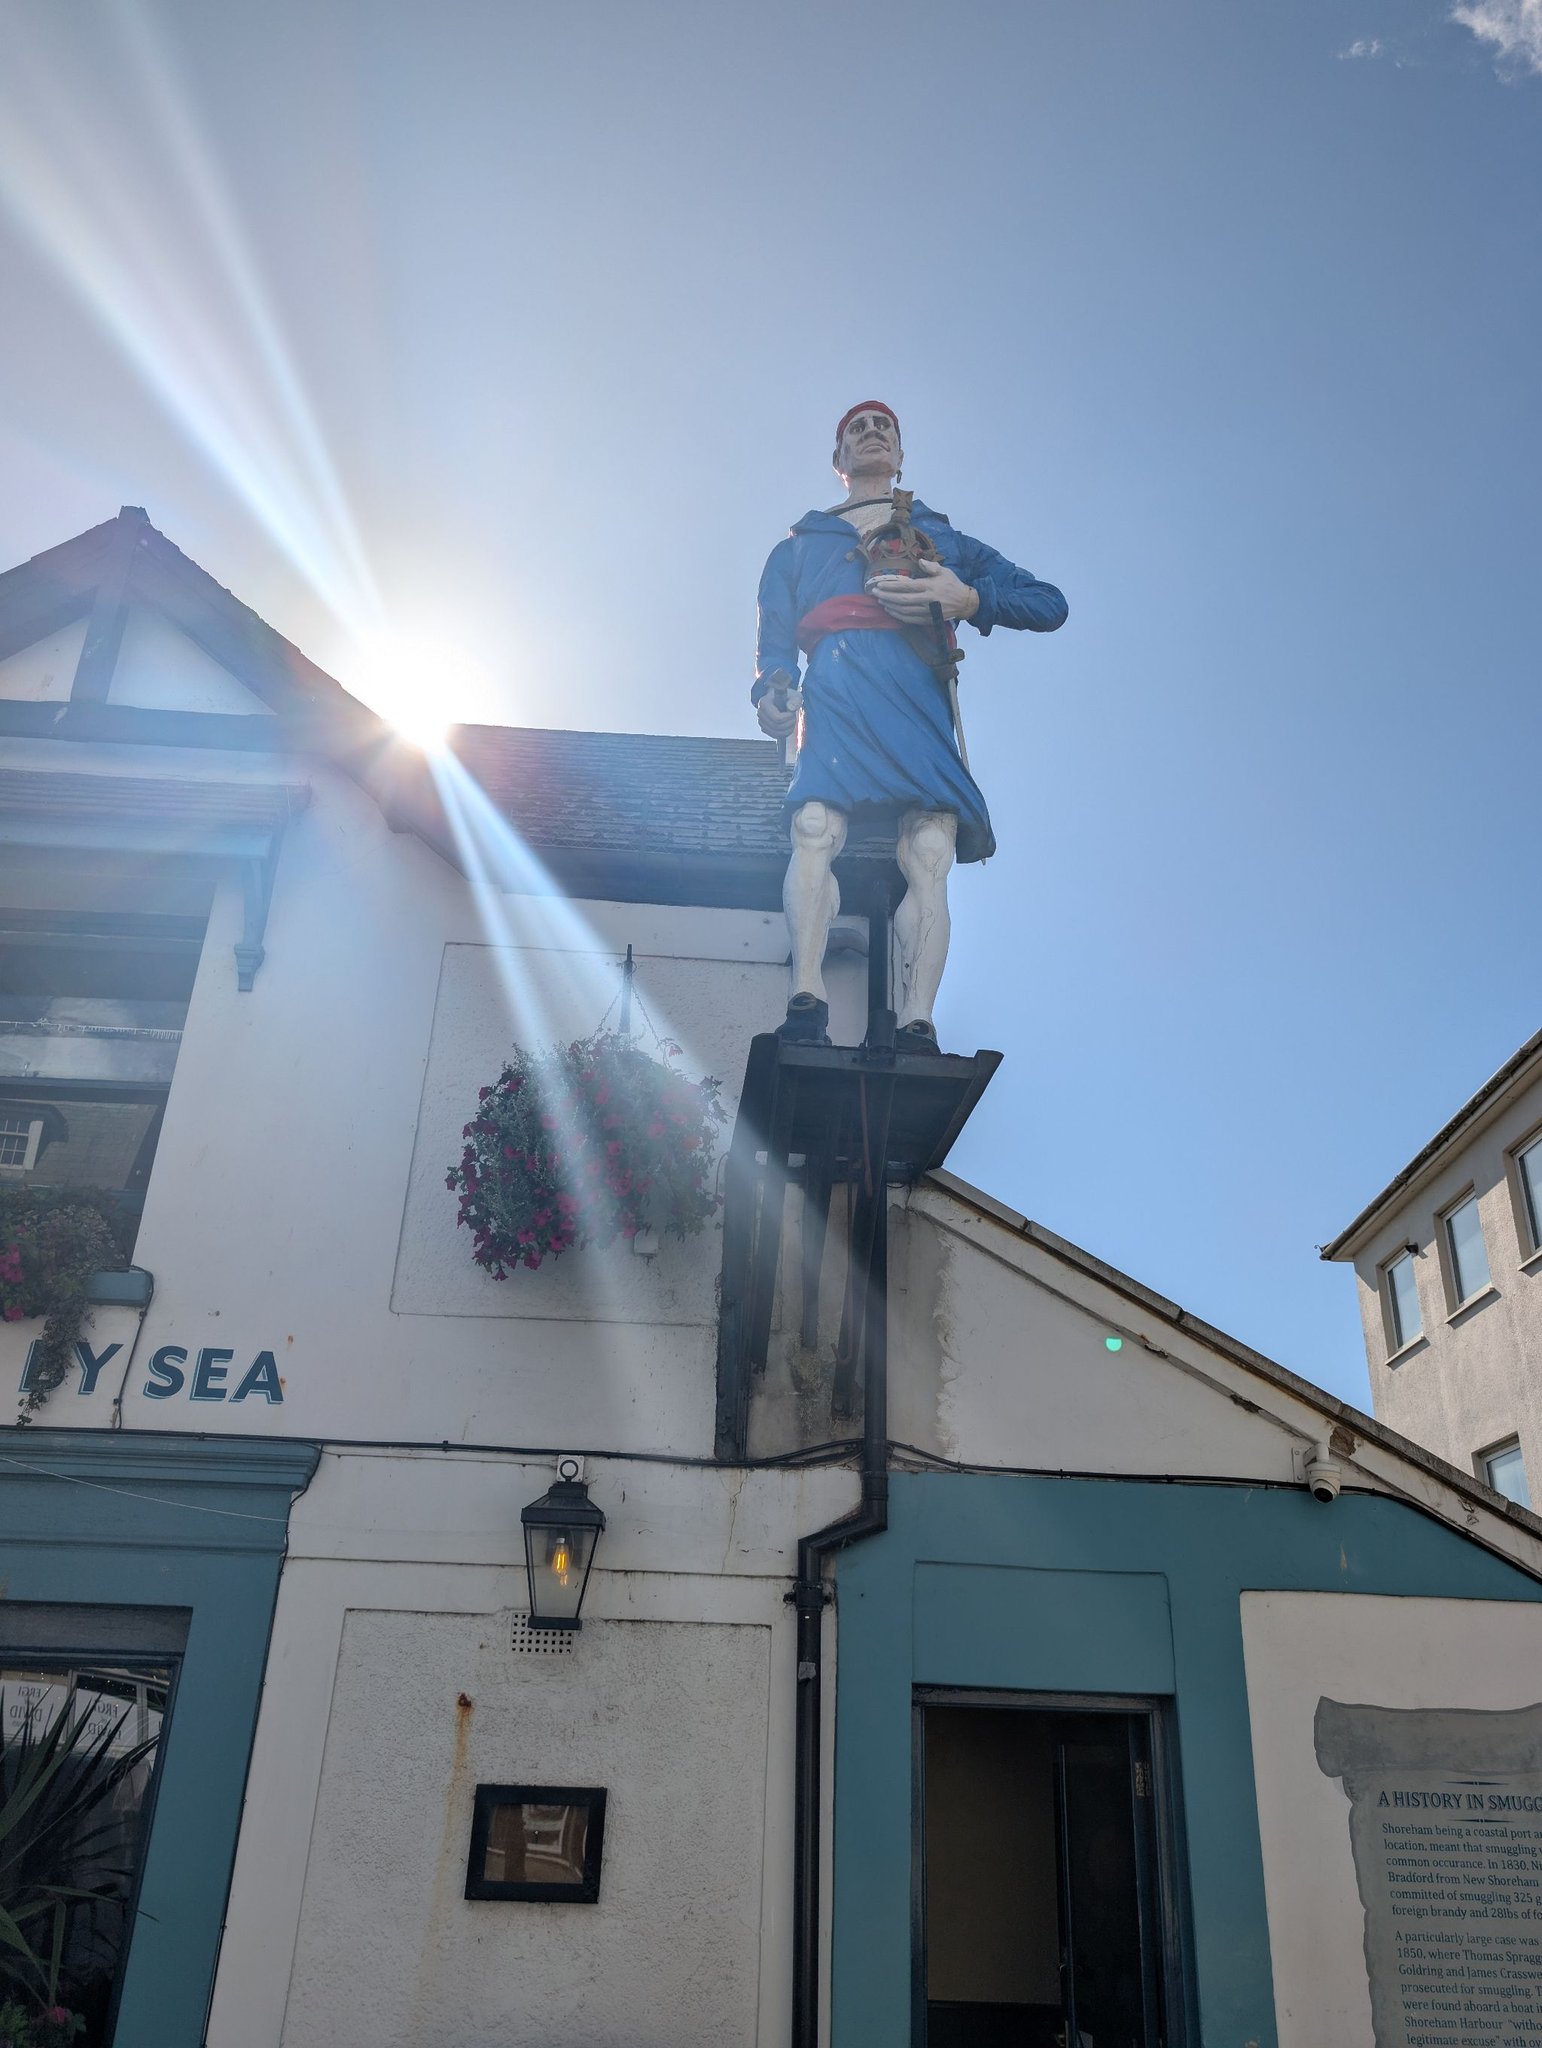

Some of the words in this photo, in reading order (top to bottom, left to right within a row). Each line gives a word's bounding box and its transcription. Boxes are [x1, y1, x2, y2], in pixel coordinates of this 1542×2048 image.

[143, 1345, 284, 1404] SEA
[1377, 1791, 1390, 1808] A
[1392, 1791, 1462, 1810] HISTORY
[1465, 1794, 1484, 1810] IN
[1382, 1823, 1433, 1835] Shoreham
[1435, 1824, 1463, 1839] being
[1465, 1828, 1471, 1836] a
[1473, 1826, 1508, 1838] coastal
[1510, 1829, 1532, 1840] port
[1429, 1843, 1460, 1852] meant
[1463, 1842, 1483, 1853] that
[1485, 1843, 1537, 1858] smuggling
[1386, 1857, 1430, 1868] common
[1432, 1858, 1486, 1869] occurance.
[1488, 1860, 1498, 1869] In
[1387, 1872, 1434, 1883] Bradford
[1436, 1873, 1461, 1884] from
[1462, 1874, 1486, 1886] New
[1488, 1874, 1539, 1887] Shoreham
[1390, 1889, 1444, 1900] committed
[1446, 1890, 1457, 1901] of
[1459, 1891, 1511, 1905] smuggling
[1513, 1892, 1533, 1903] 325
[1392, 1904, 1428, 1919] foreign
[1430, 1905, 1467, 1920] brandy
[1469, 1907, 1489, 1918] and
[1491, 1907, 1519, 1919] 28lbs
[1521, 1908, 1531, 1920] of
[1395, 1930, 1403, 1941] A
[1405, 1932, 1464, 1946] particularly
[1466, 1933, 1492, 1947] large
[1495, 1936, 1516, 1946] case
[1519, 1938, 1539, 1946] was
[1428, 1949, 1461, 1960] where
[1462, 1949, 1504, 1962] Thomas
[1398, 1964, 1444, 1979] Goldring
[1446, 1965, 1465, 1977] and
[1467, 1966, 1497, 1980] James
[1500, 1968, 1542, 1980] Crasswe
[1401, 1982, 1458, 1995] prosecuted
[1460, 1983, 1475, 1994] for
[1478, 1985, 1533, 1999] smuggling.
[1403, 2000, 1429, 2010] were
[1431, 1999, 1462, 2011] found
[1463, 2000, 1500, 2013] aboard
[1502, 2004, 1509, 2013] a
[1510, 2001, 1534, 2013] boat
[1404, 2016, 1457, 2029] Shoreham
[1459, 2017, 1504, 2030] Harbour
[1407, 2033, 1458, 2048] legitimate
[1502, 2037, 1526, 2047] with
